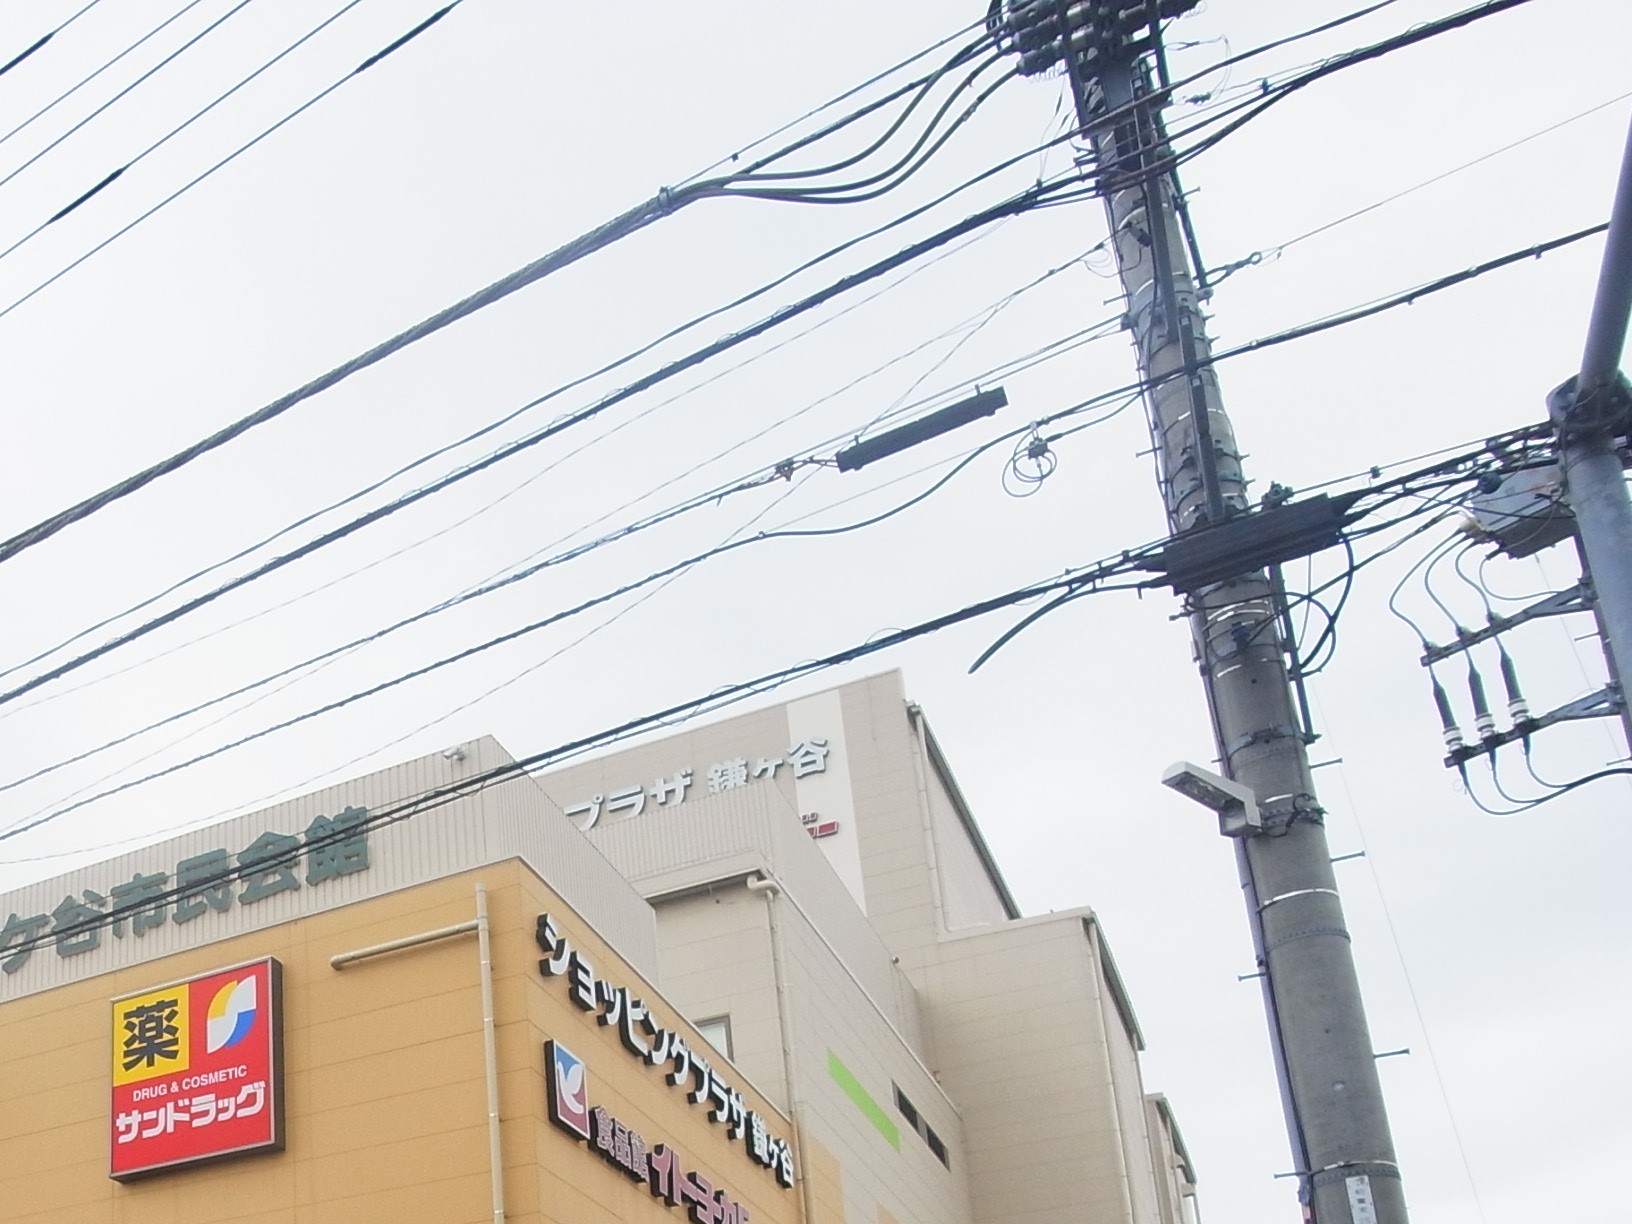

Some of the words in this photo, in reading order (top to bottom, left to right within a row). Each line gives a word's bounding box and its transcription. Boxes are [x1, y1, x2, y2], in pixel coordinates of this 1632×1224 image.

[122, 998, 180, 1071] 薬
[116, 1080, 266, 1144] サンドラッグ
[132, 1083, 168, 1102] DRUG
[170, 1081, 180, 1093] &
[182, 1065, 248, 1090] COSMETIC
